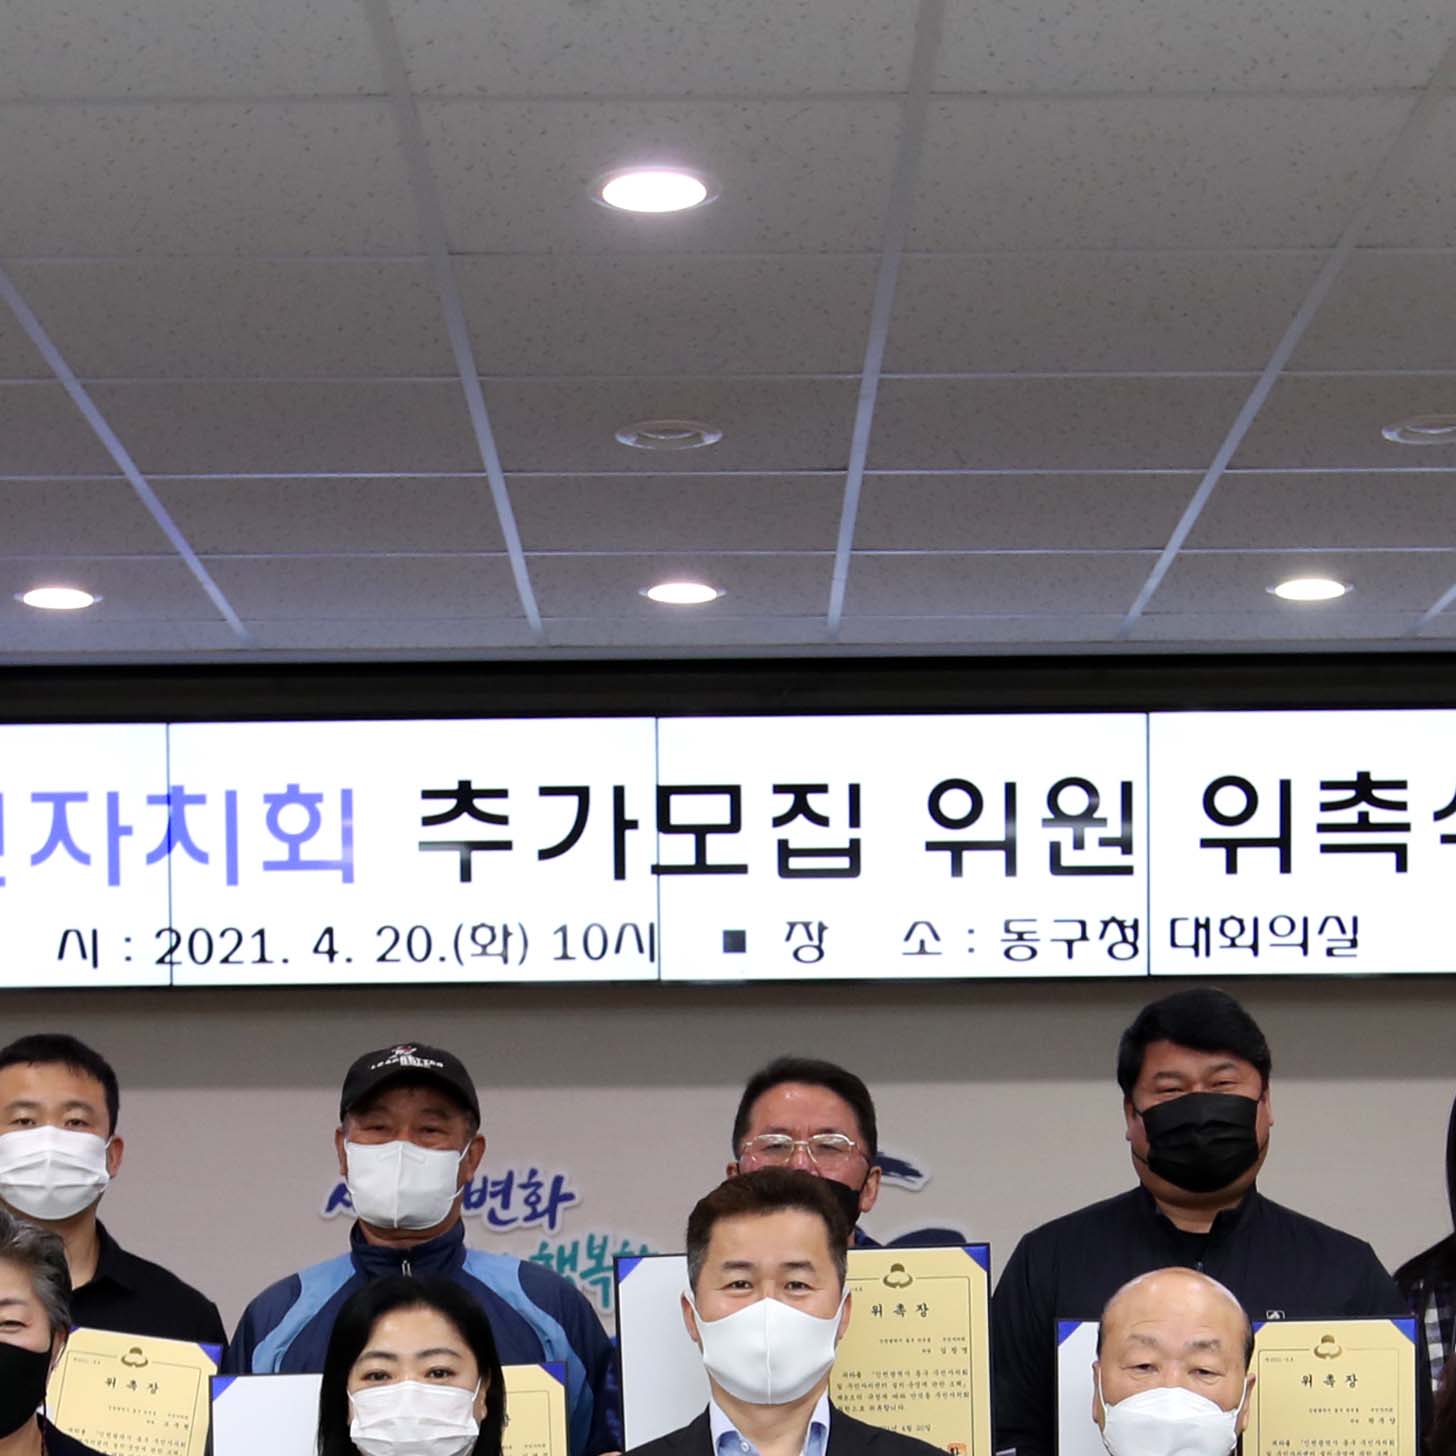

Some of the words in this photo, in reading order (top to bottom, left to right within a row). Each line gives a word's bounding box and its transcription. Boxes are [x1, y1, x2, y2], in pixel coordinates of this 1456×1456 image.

[418, 780, 862, 883] 추가모집
[925, 776, 1134, 878] 위원
[154, 925, 290, 965] 2021.
[313, 925, 353, 964] 4.
[375, 921, 529, 966] 20.(화)
[552, 921, 656, 965] 10시
[1000, 915, 1141, 962] 동구청
[1170, 914, 1360, 959] 대회의실
[463, 1167, 576, 1231] 변화
